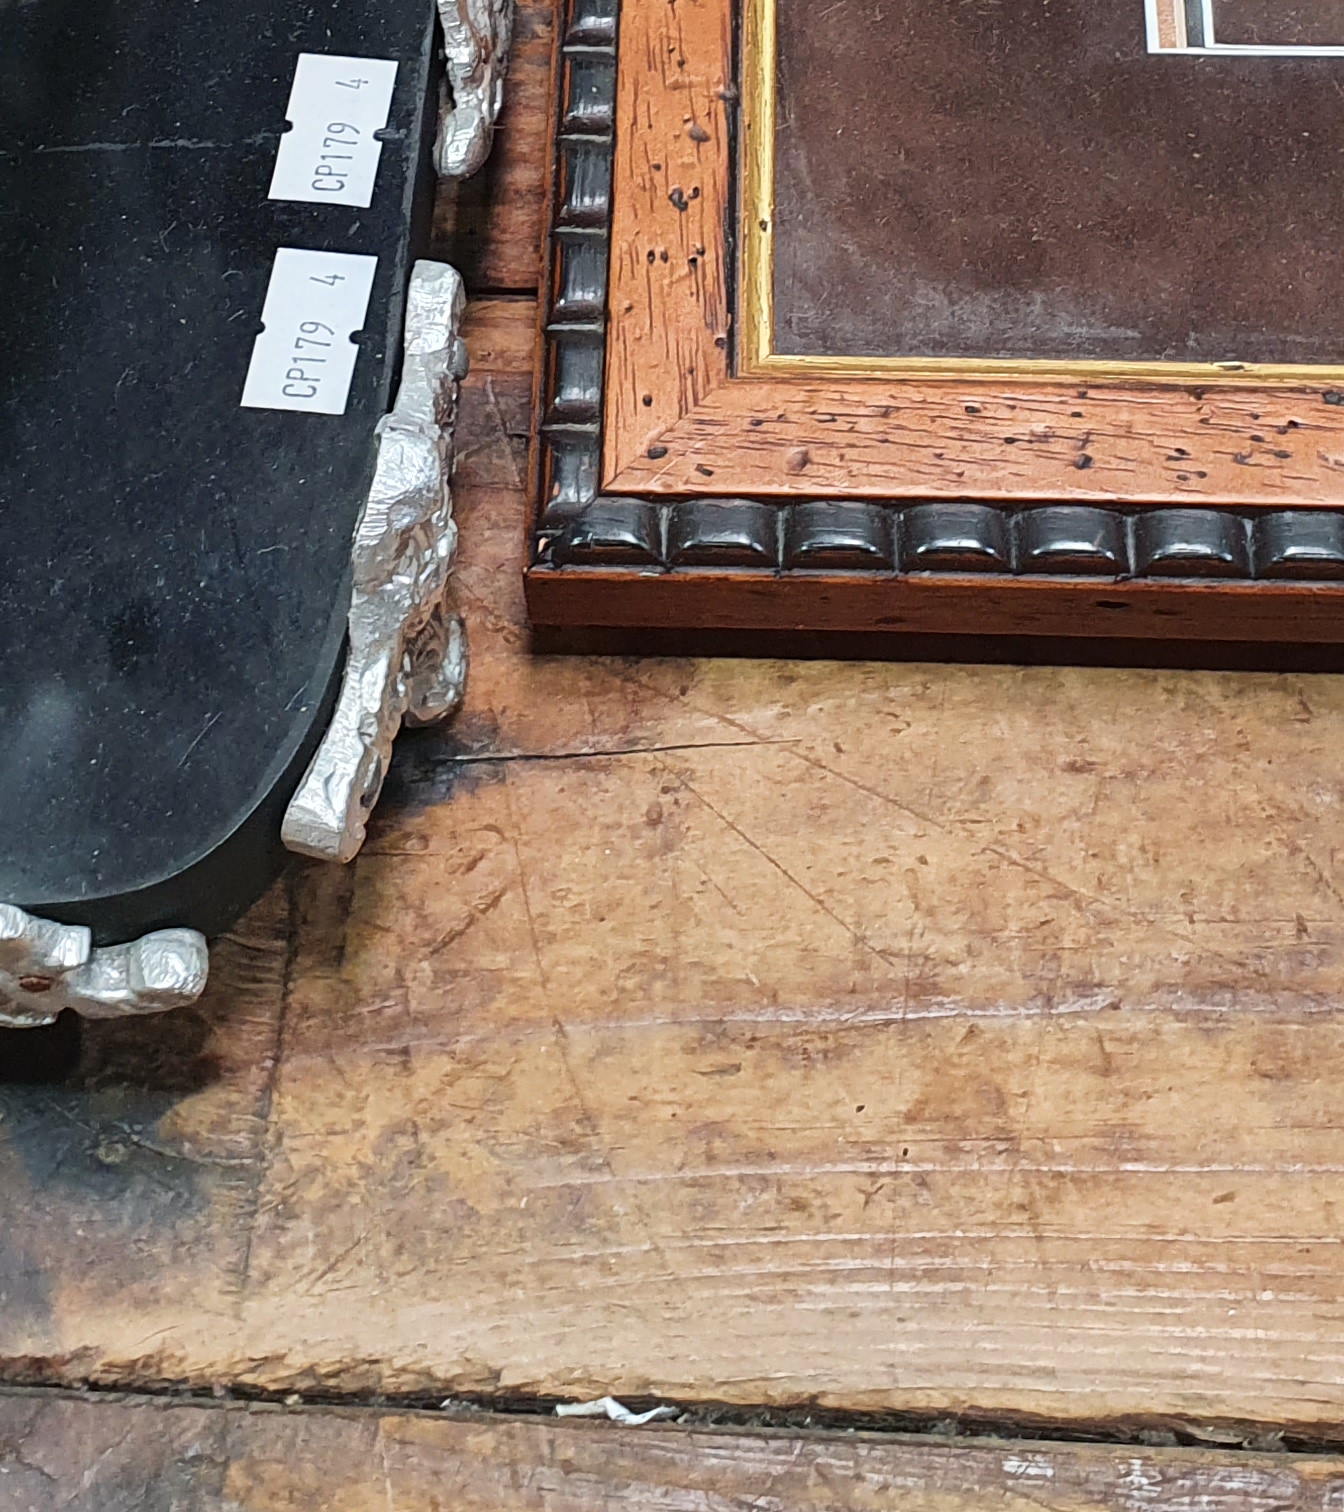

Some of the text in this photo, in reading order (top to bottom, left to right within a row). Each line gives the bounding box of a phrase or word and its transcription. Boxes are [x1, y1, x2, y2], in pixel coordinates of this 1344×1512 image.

[311, 77, 370, 193] CP179 4
[281, 273, 346, 399] CP179 4
